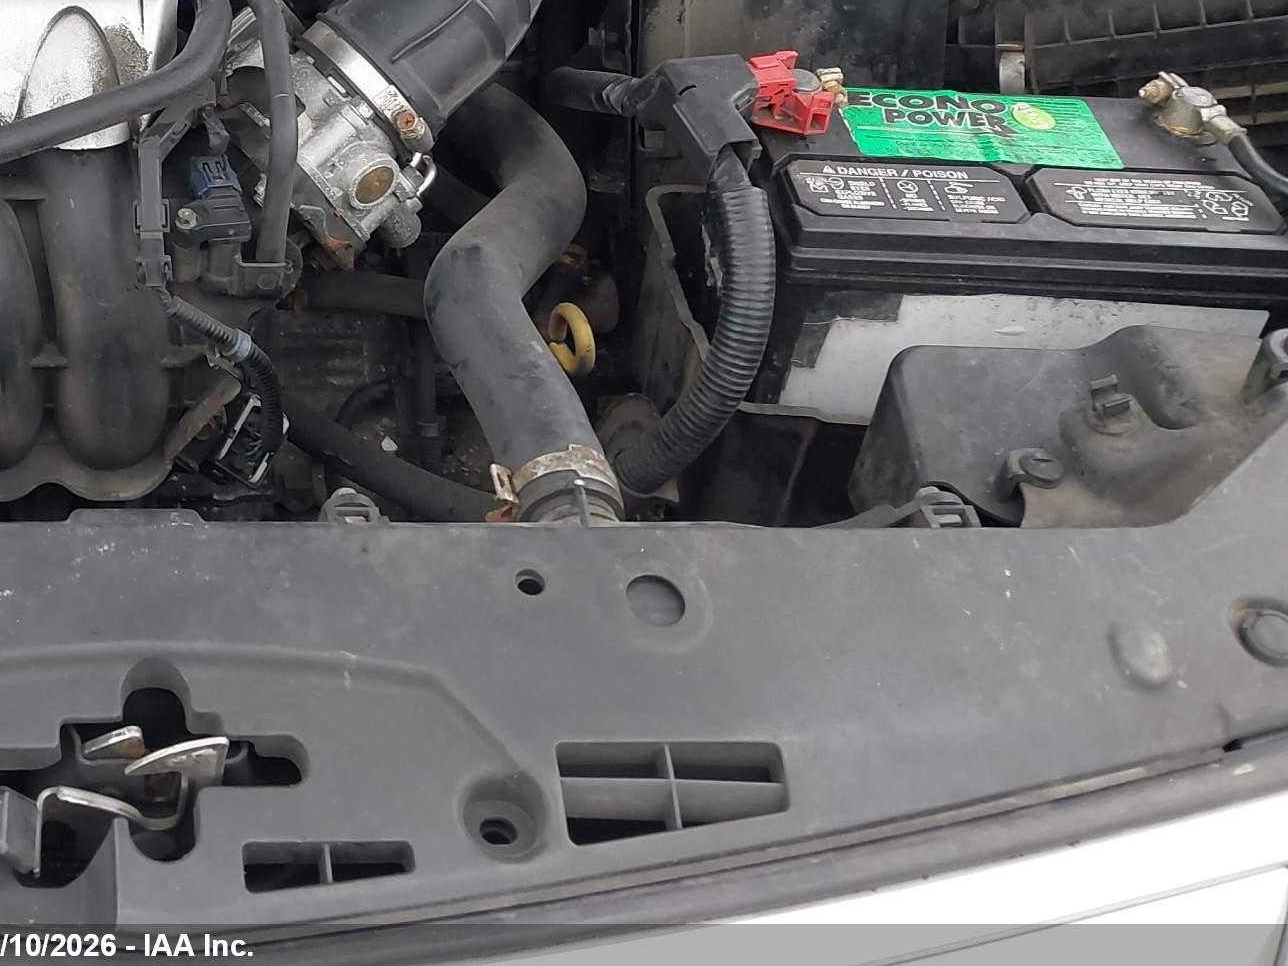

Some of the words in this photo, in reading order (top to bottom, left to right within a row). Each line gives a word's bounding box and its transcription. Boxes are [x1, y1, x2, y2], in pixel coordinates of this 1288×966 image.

[846, 91, 1007, 116] ECONO
[883, 107, 1020, 138] POWER
[837, 165, 897, 177] DANGER
[913, 169, 969, 180] POISON
